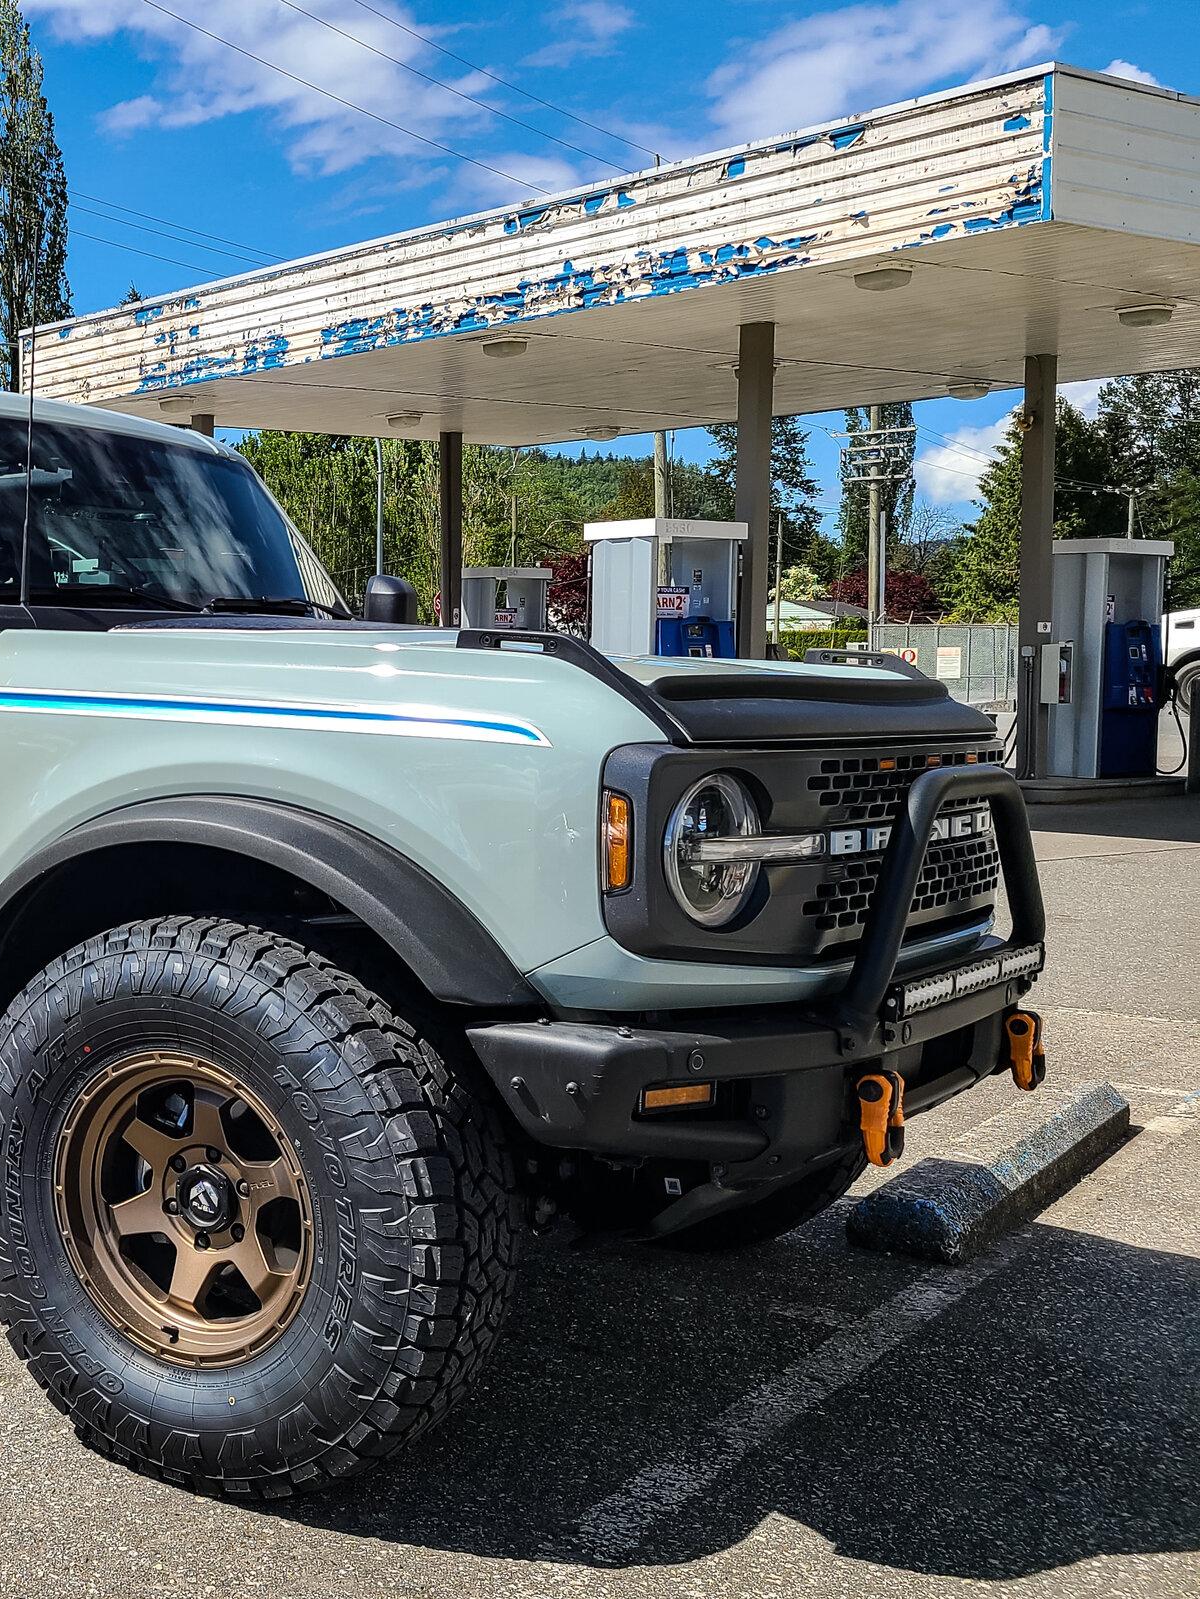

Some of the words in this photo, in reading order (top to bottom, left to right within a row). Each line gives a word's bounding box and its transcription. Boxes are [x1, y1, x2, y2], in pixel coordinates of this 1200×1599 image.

[657, 597, 675, 608] ARN
[494, 614, 509, 622] ARN
[830, 810, 991, 855] BRNCO
[249, 1180, 275, 1191] FUEL
[5, 1106, 48, 1299] COUNTRY
[192, 1200, 215, 1214] FUEL
[273, 1064, 347, 1188] TOYO
[323, 1196, 357, 1352] TIRES
[40, 1306, 125, 1396] OPEN
